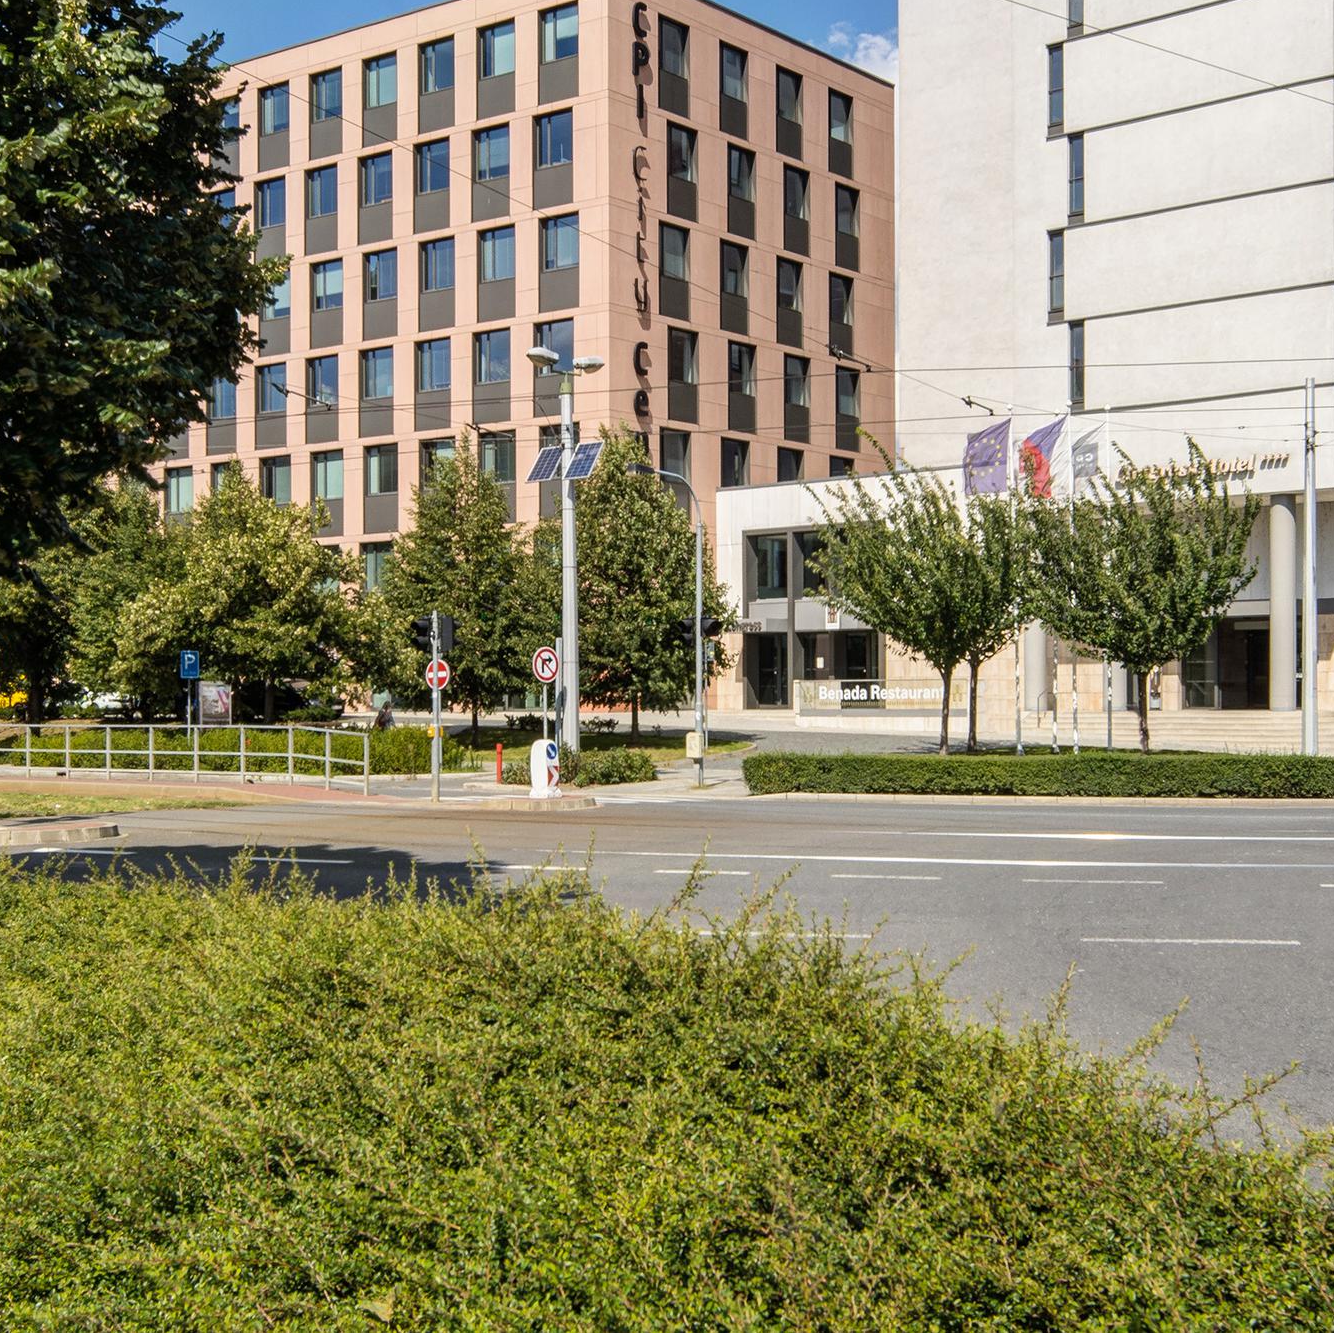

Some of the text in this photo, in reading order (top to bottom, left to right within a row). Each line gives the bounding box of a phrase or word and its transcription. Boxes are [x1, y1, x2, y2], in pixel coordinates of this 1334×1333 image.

[632, 1, 650, 119] CPI
[818, 684, 945, 701] Benada Restaurant
